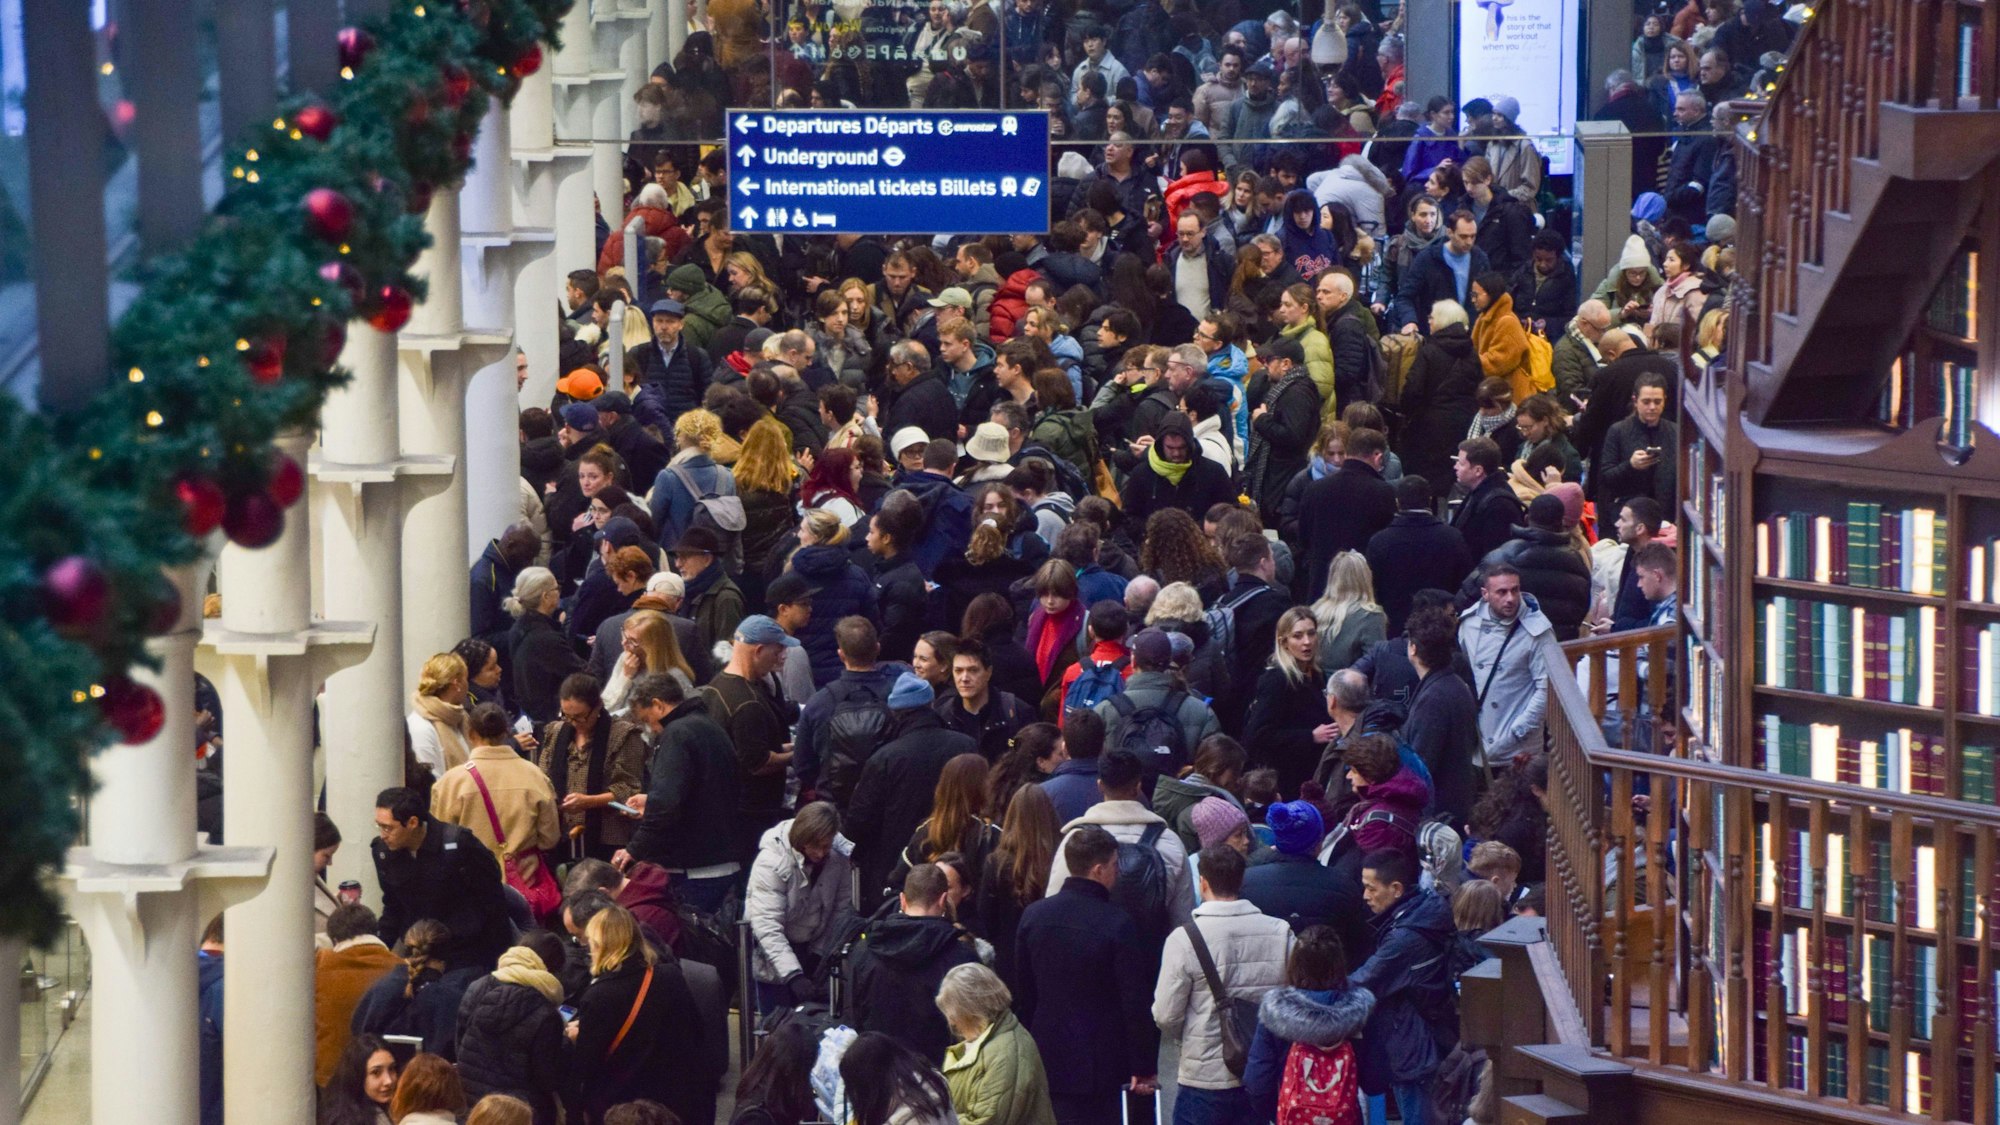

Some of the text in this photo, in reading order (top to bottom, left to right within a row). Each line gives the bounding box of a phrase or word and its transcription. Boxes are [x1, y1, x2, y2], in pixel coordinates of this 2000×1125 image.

[1506, 23, 1526, 31] story
[1482, 43, 1504, 51] when
[763, 116, 862, 137] Departures
[864, 116, 934, 137] Départs
[764, 147, 879, 169] Underground
[765, 178, 997, 196] International tickets Billets
